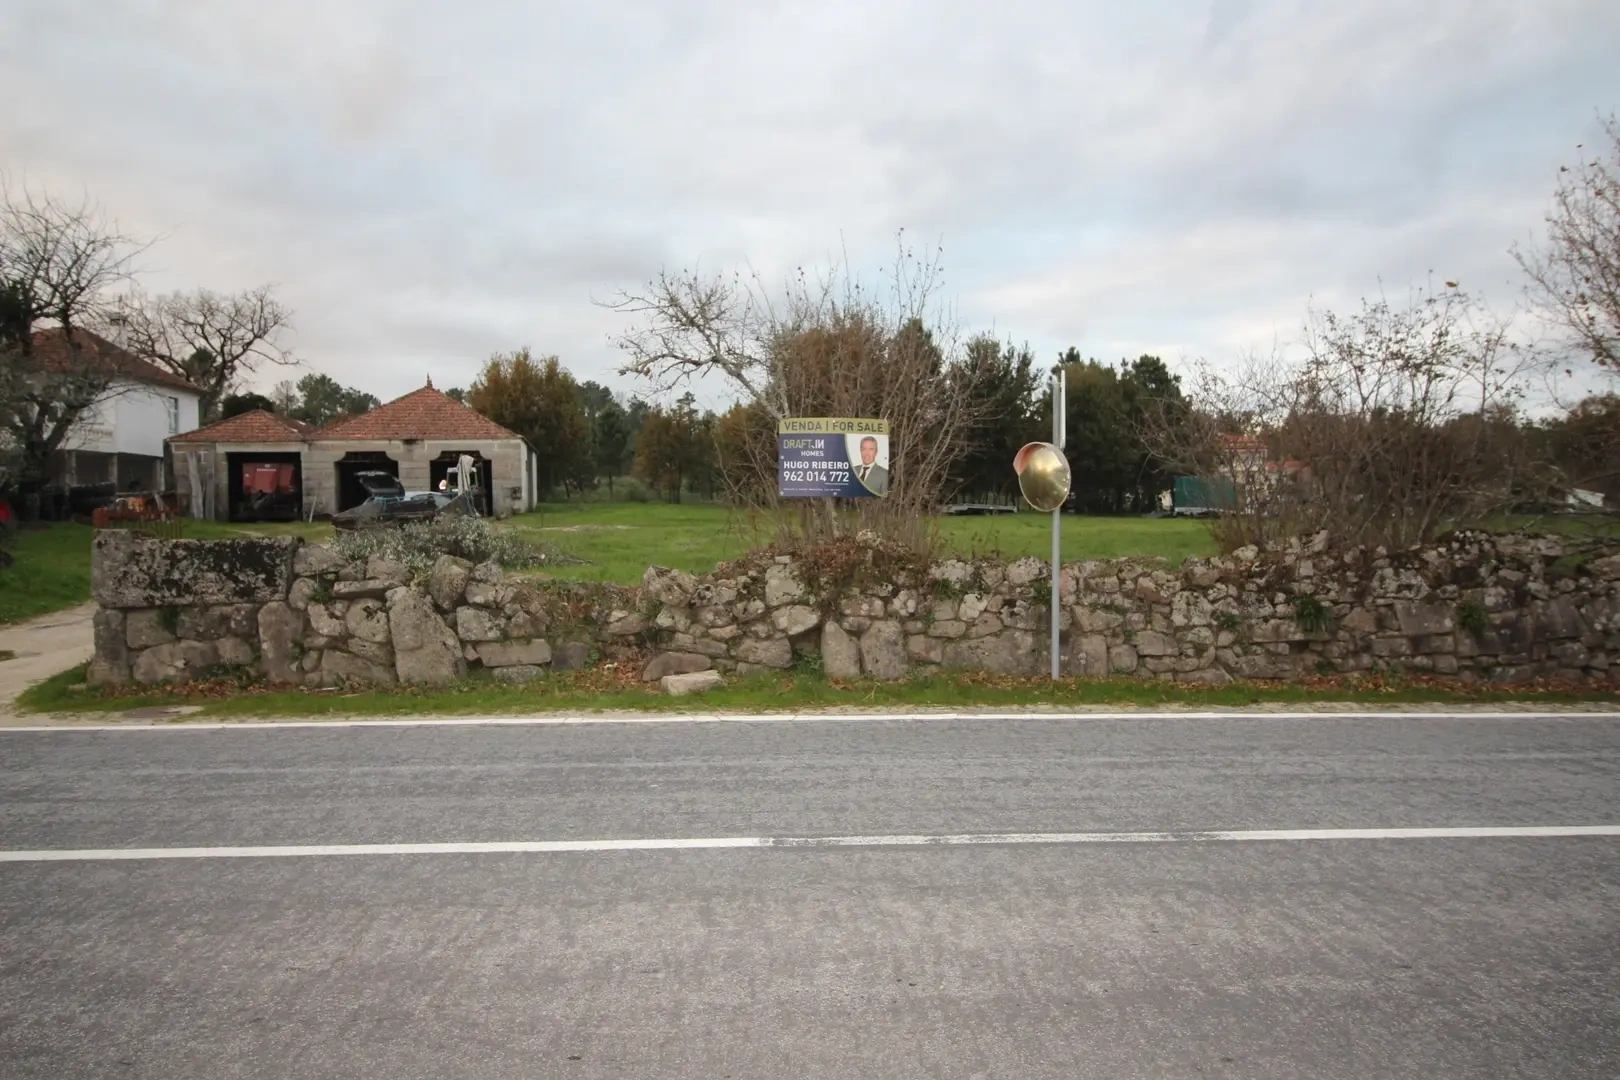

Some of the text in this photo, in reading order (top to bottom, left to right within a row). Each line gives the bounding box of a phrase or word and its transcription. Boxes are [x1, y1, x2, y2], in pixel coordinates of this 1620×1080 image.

[784, 421, 822, 431] VENDA
[832, 421, 854, 432] FOR
[857, 422, 884, 433] SALE
[783, 461, 850, 470] HUGO RIBEIRO
[783, 471, 850, 482] 962 014 772
